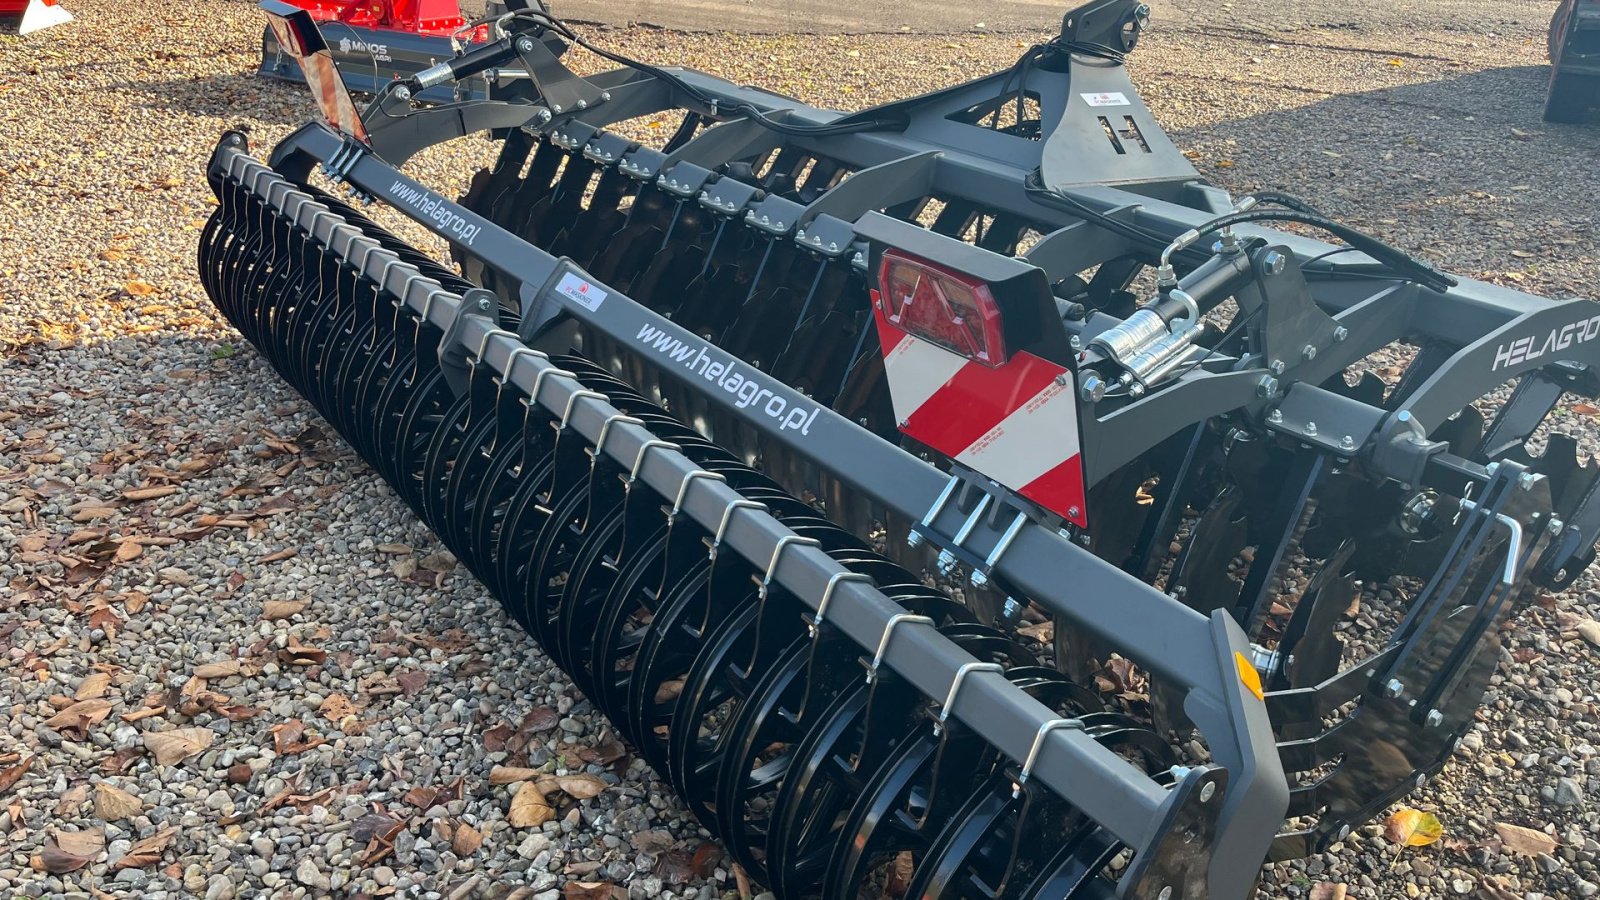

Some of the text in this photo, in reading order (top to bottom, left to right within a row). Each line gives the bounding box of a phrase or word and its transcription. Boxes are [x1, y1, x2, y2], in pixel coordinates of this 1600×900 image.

[1097, 115, 1152, 154] H
[389, 180, 481, 245] www.helagro.pl
[1491, 315, 1600, 371] HELAGRO
[636, 323, 820, 436] www.helagro.pl
